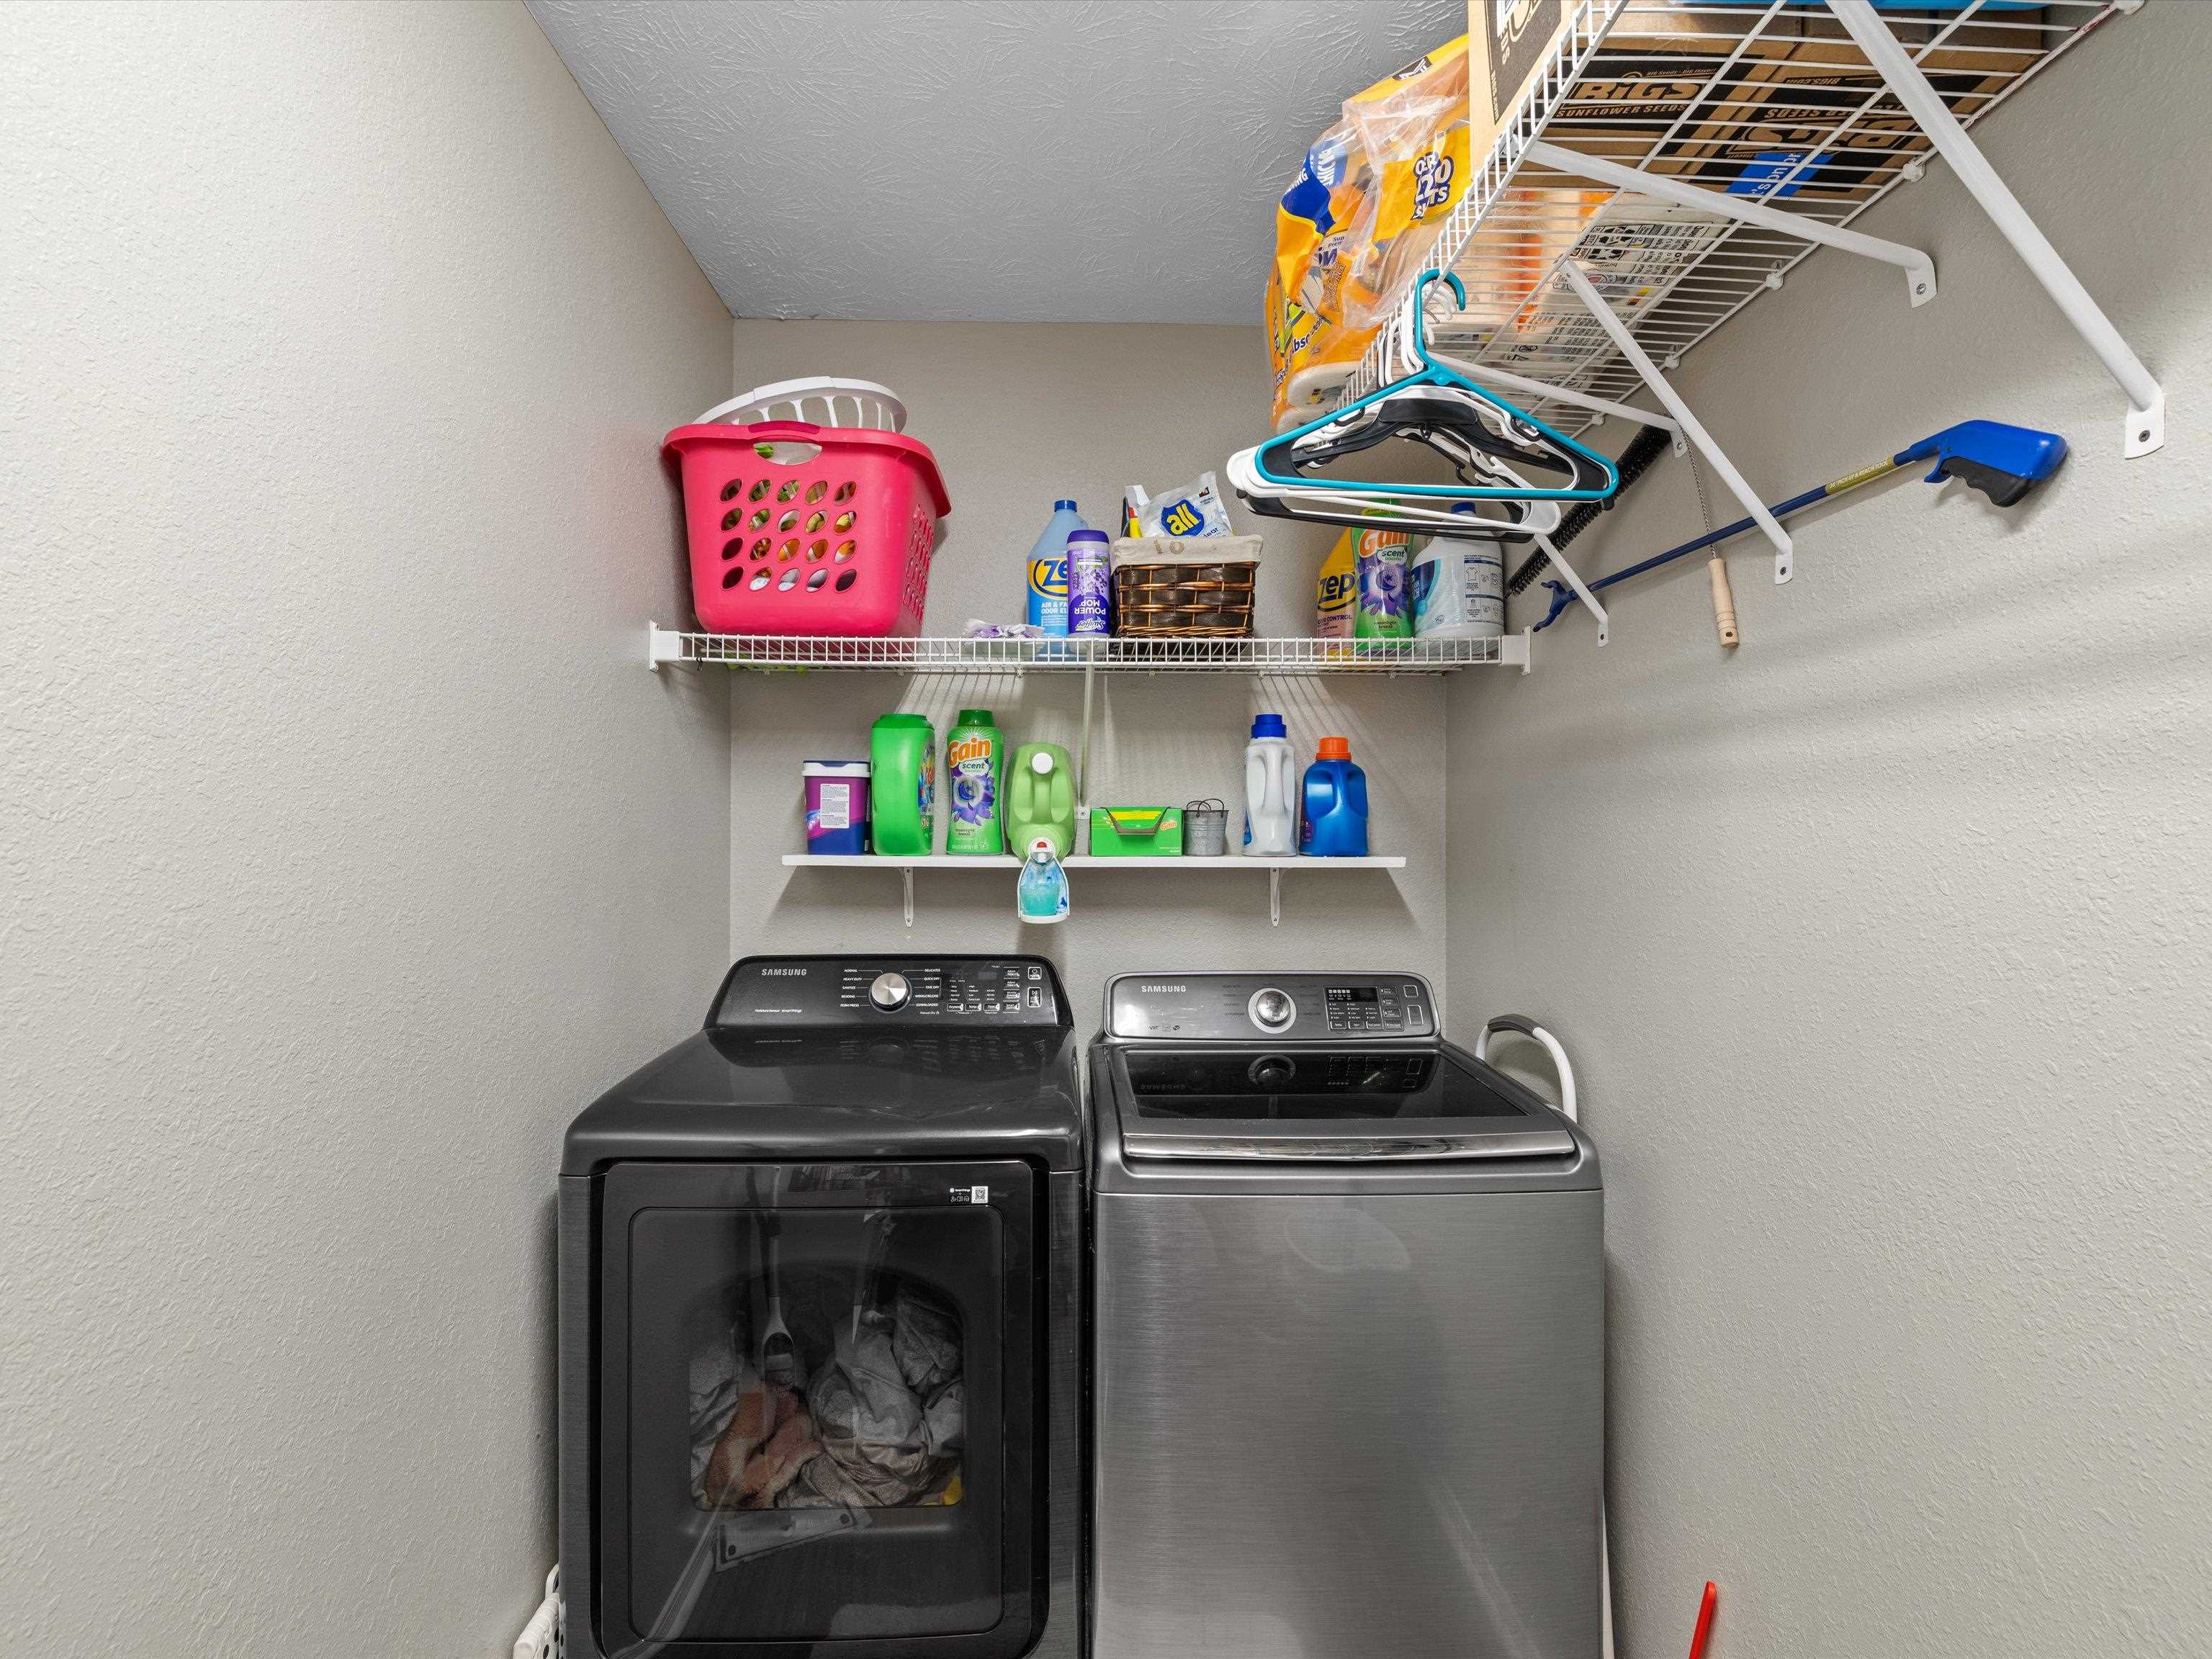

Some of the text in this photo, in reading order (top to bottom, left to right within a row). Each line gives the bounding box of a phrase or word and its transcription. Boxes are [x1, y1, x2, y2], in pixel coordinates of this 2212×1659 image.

[1557, 104, 1686, 117] SUNFLOWER SEEDS
[1166, 503, 1200, 535] all
[1076, 619, 1106, 631] Swiffer
[948, 737, 992, 768] Gain
